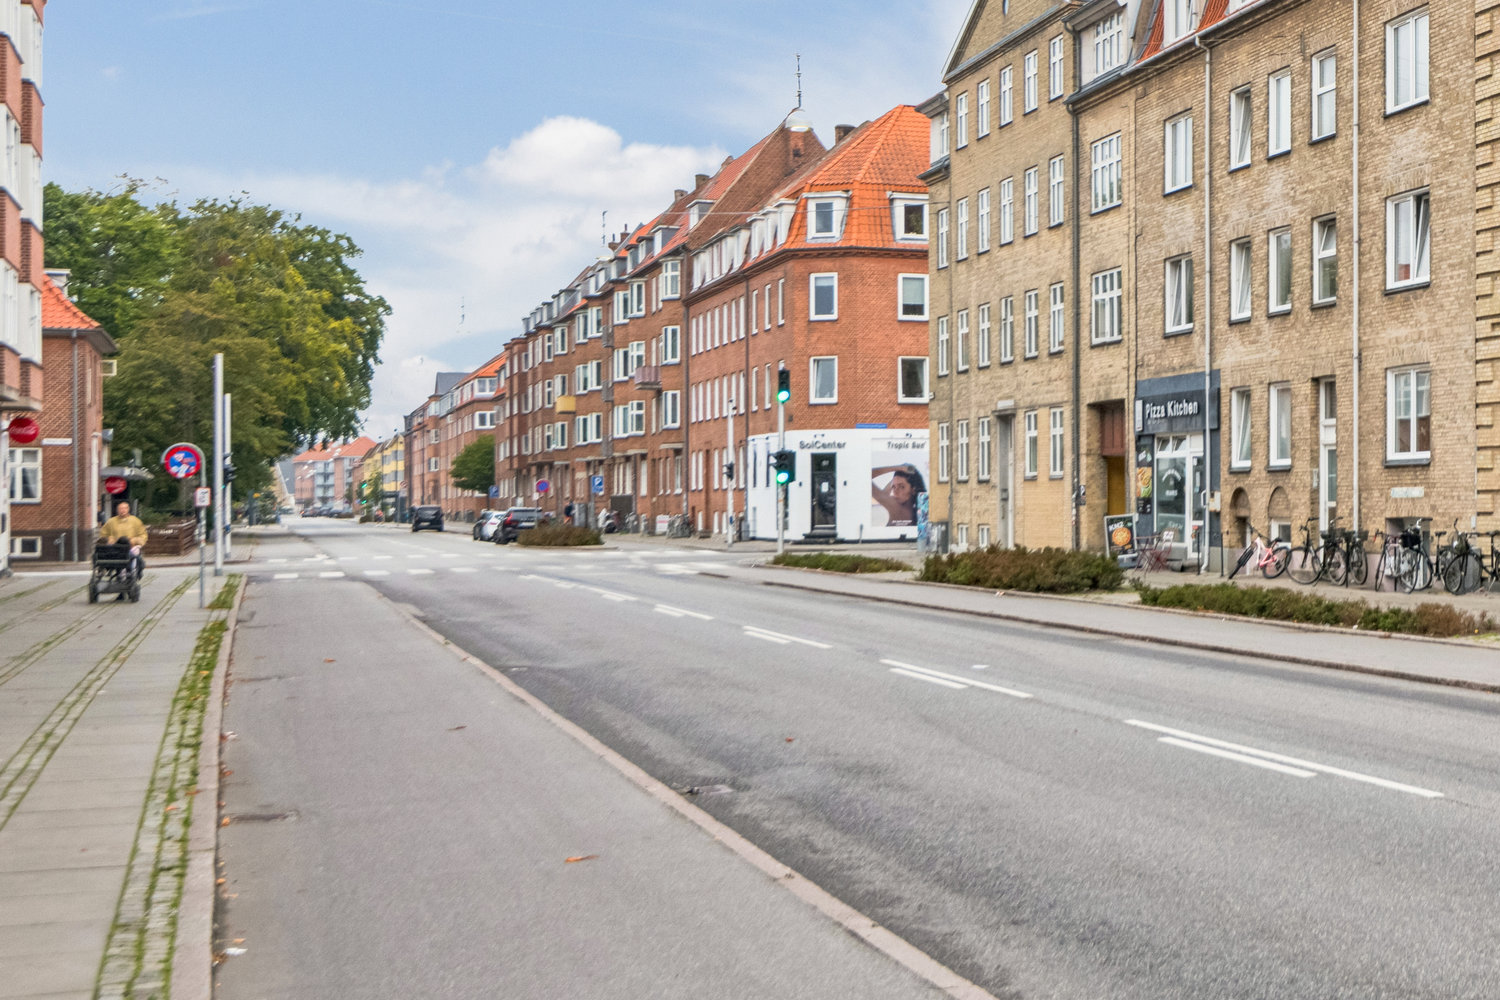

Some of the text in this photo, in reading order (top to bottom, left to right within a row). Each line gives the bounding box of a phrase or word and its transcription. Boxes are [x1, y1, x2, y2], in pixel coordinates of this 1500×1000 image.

[1145, 399, 1198, 420] Pizza Kitchen
[799, 440, 847, 450] SolCenter
[887, 441, 909, 450] Tropic
